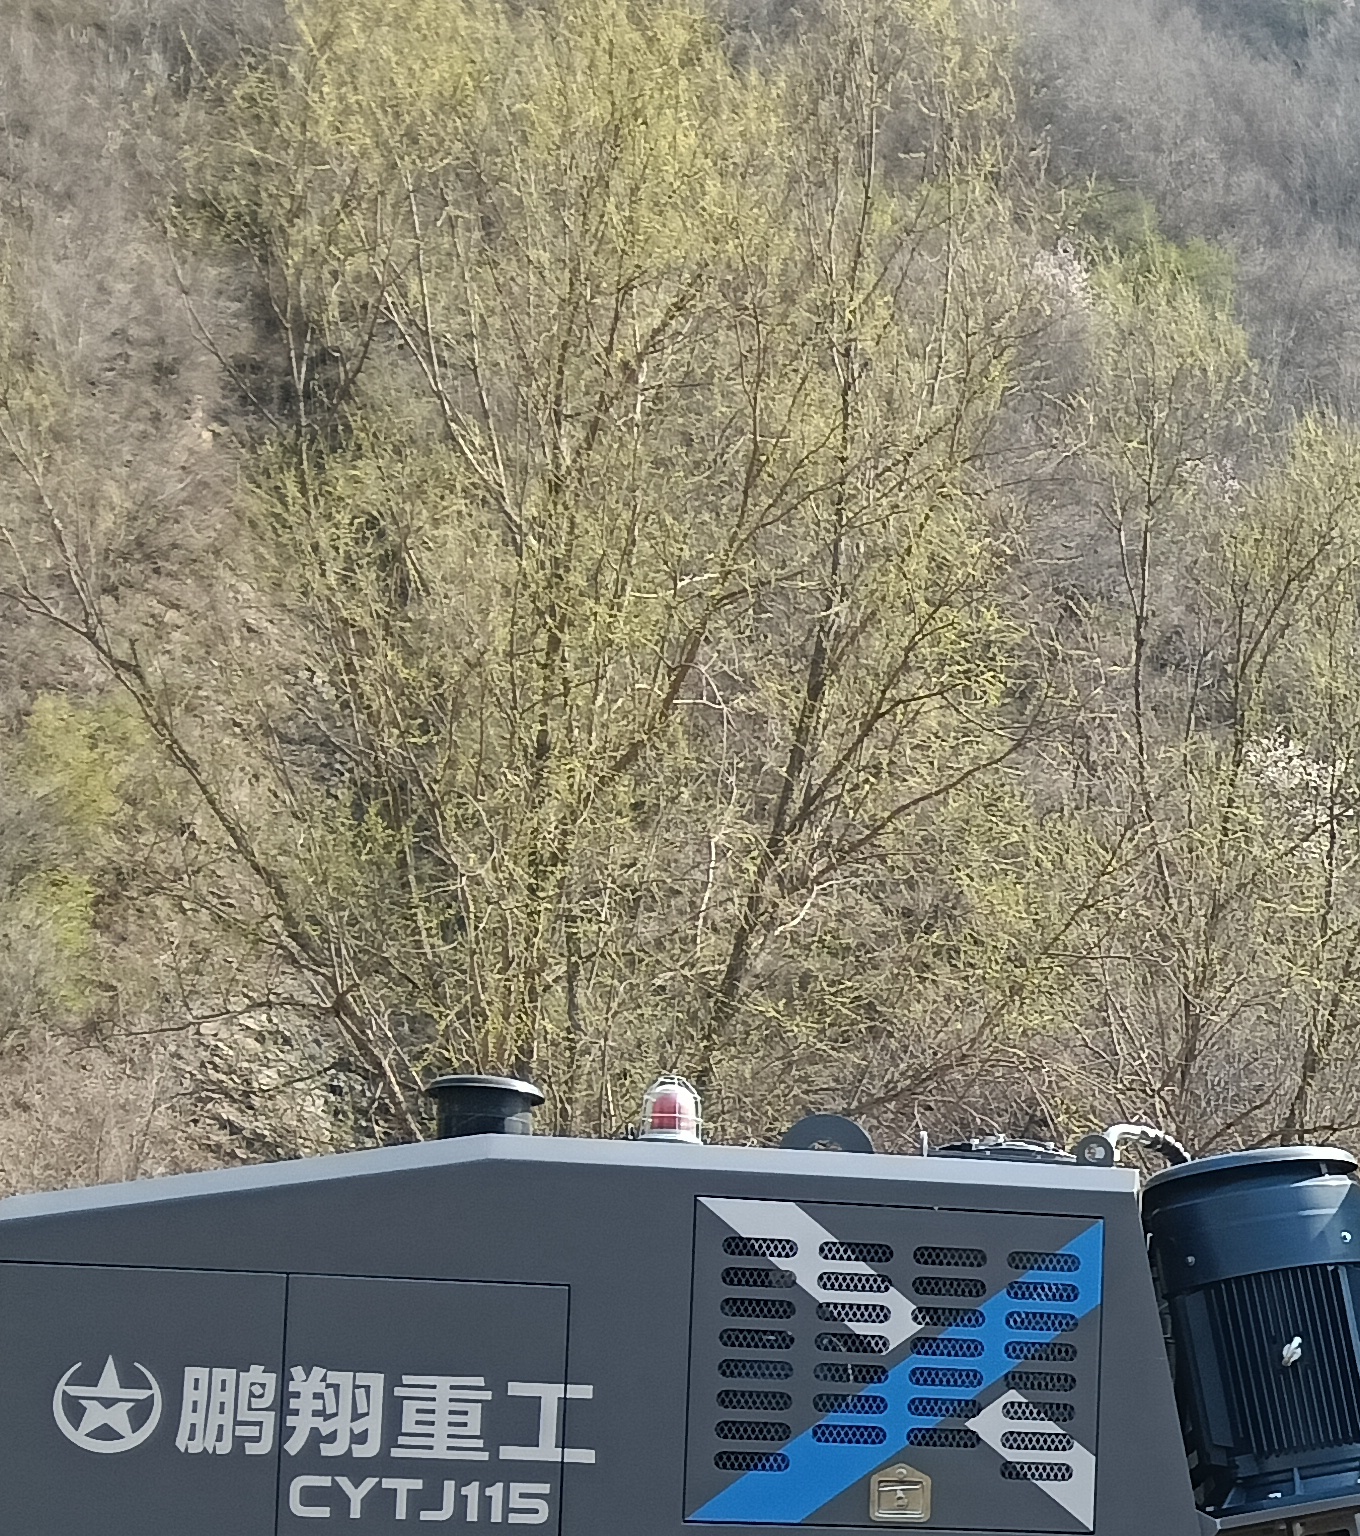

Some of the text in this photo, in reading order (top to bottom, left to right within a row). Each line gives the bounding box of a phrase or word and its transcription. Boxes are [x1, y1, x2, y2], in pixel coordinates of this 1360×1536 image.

[175, 1363, 596, 1464] 鹏翔重工
[289, 1475, 551, 1525] CYTJ115
